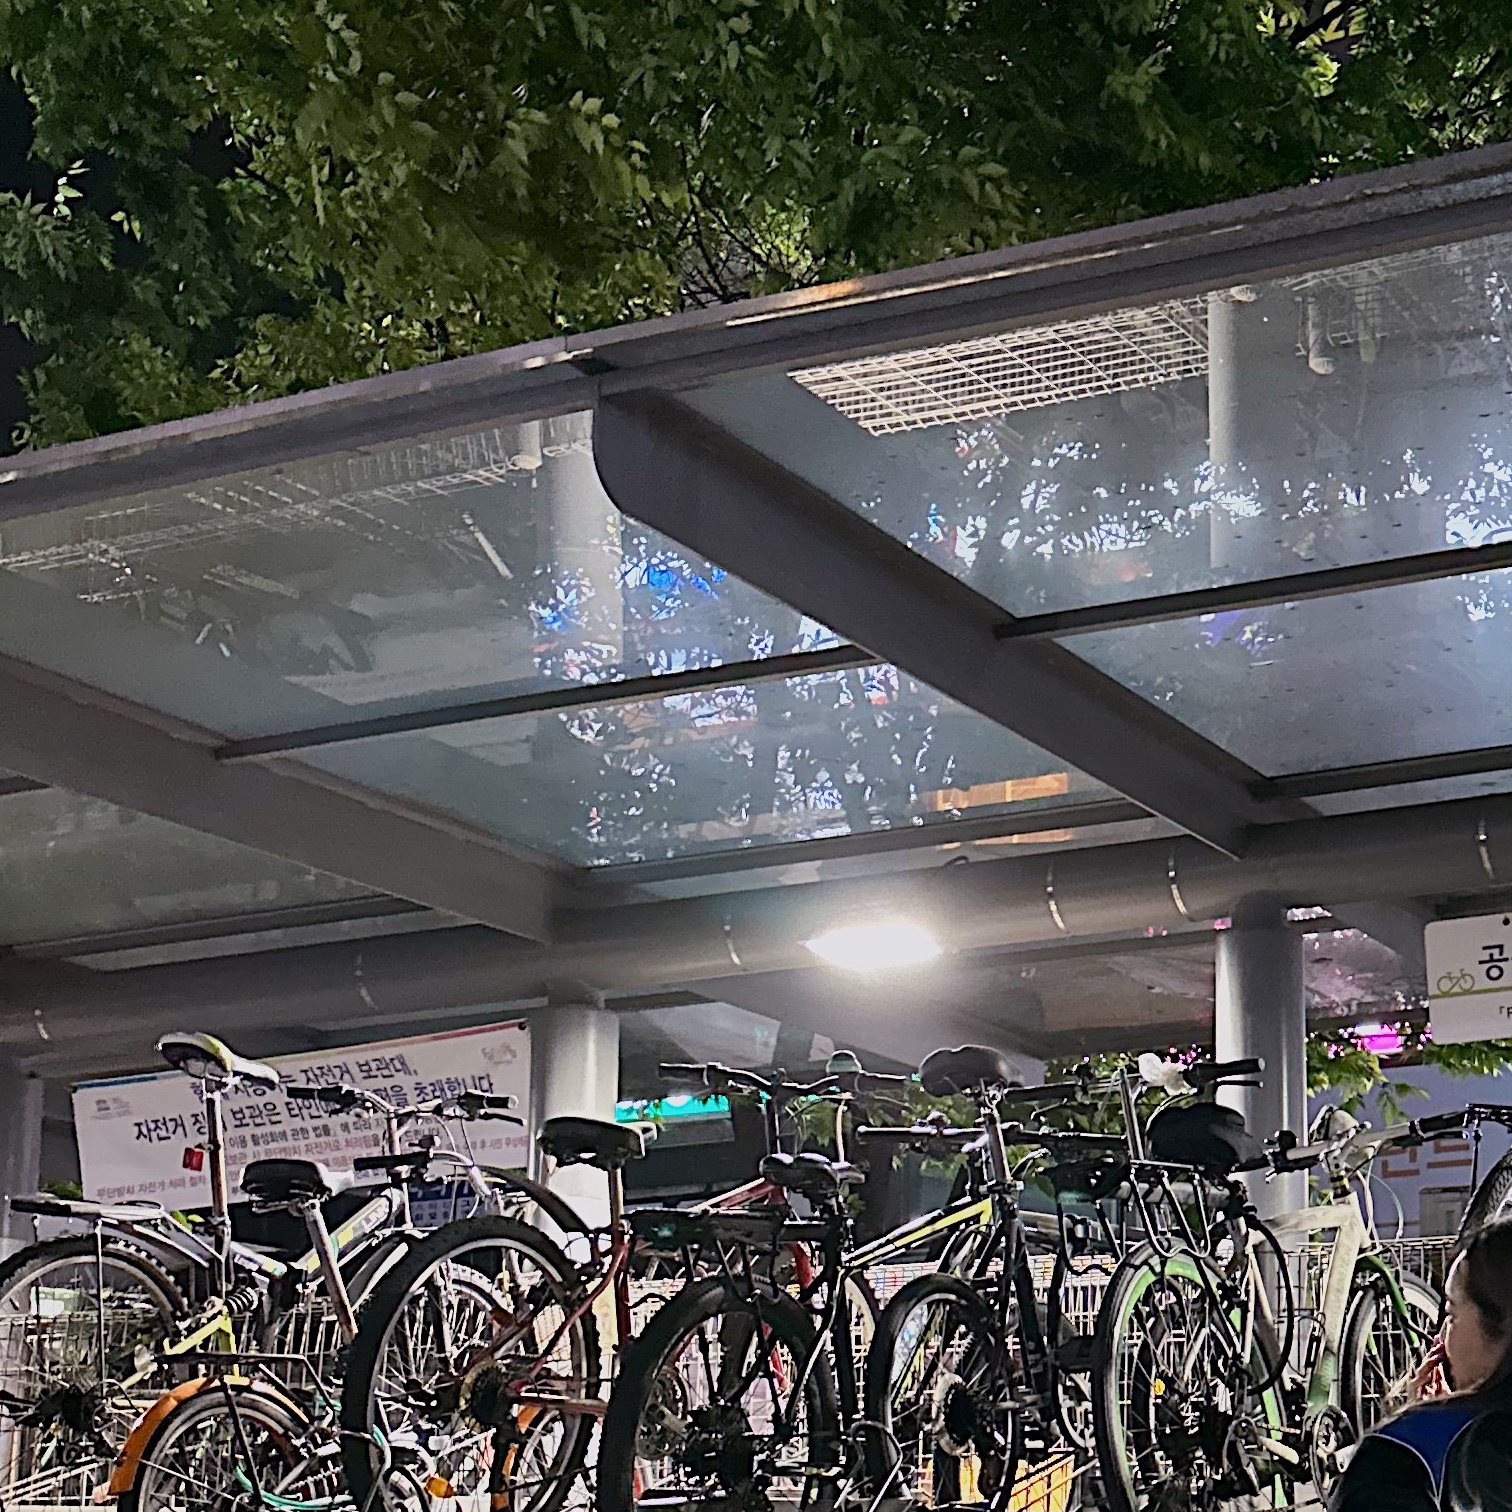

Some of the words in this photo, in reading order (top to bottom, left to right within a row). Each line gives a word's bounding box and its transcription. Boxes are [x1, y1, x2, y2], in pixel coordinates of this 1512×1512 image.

[300, 1062, 355, 1086] 자전거
[355, 1053, 418, 1080] 보관대,
[133, 1114, 188, 1144] 자전거
[230, 1101, 282, 1129] 보관은
